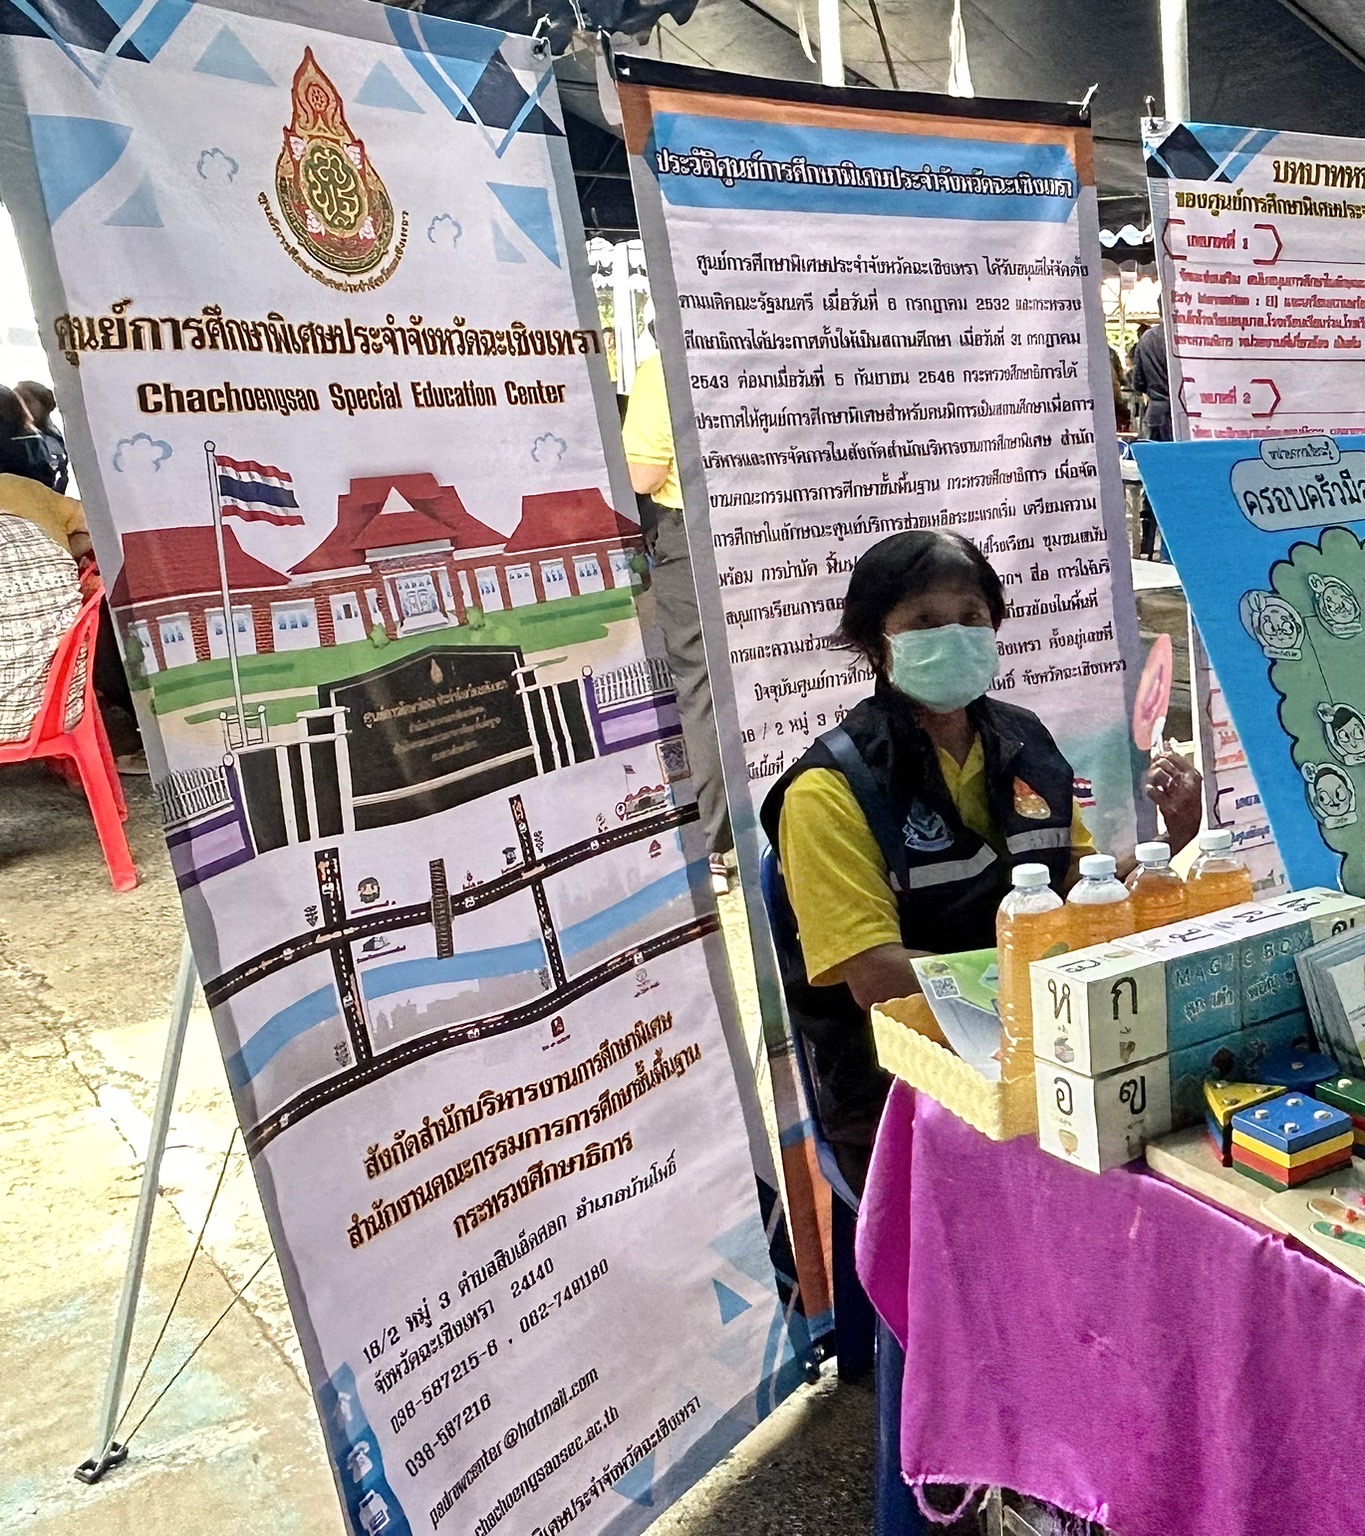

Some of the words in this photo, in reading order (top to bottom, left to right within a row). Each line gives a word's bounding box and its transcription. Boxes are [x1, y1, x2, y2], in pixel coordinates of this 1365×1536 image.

[655, 145, 1075, 198] ประวัติศูนย์การศึกษาพิเศษประจำจังหวัดฉะเชิงเทรา
[696, 250, 979, 277] ศูนย์การศึกษาพิเศษประจำจังหวัดฉะเชิงเทรา
[822, 288, 879, 311] เมื่อวันที่
[906, 297, 968, 314] กรกฎาคม
[54, 297, 600, 368] ศูนย์การศึกษาพิเศษประจำจังหวัดฉะเชิงเทรา
[959, 326, 1005, 347] เมื่อวันที่
[1026, 331, 1081, 348] กรกฎาคม
[690, 375, 729, 389] 2543
[737, 364, 825, 389] ต่อมาเมื่อวันที่
[834, 373, 845, 387] 5
[854, 367, 910, 386] กันยายน
[136, 381, 320, 417] Chachoengsao
[328, 380, 402, 417] Special
[410, 379, 497, 409] Education
[504, 379, 566, 406] Center
[1060, 427, 1095, 446] สำนัก
[1055, 458, 1097, 480] เพื่อจัด
[719, 566, 753, 587] พร้อม
[775, 721, 784, 736] 2
[789, 711, 809, 736] หมู่
[1047, 978, 1072, 1024] ห
[1110, 976, 1138, 1021] ก
[363, 1011, 673, 1181] สังกัดสำนักบริหารงานการศึกษาพิเศษ
[1054, 1076, 1074, 1116] อ
[346, 1043, 702, 1250] สำนักงานคณะกรรมการการศึกษาขั้นพื้นฐาน
[452, 1131, 634, 1239] กระทรวงศึกษาธิการ
[405, 1297, 433, 1333] หมู่
[438, 1291, 452, 1311] 3
[458, 1213, 568, 1298] ตำบลสิบเอ็ดศอก
[575, 1148, 679, 1221] อำเภอบ้านโพธิ์
[373, 1299, 495, 1396] จังหวัดฉะเชิงเทรา
[510, 1256, 555, 1299] 24140
